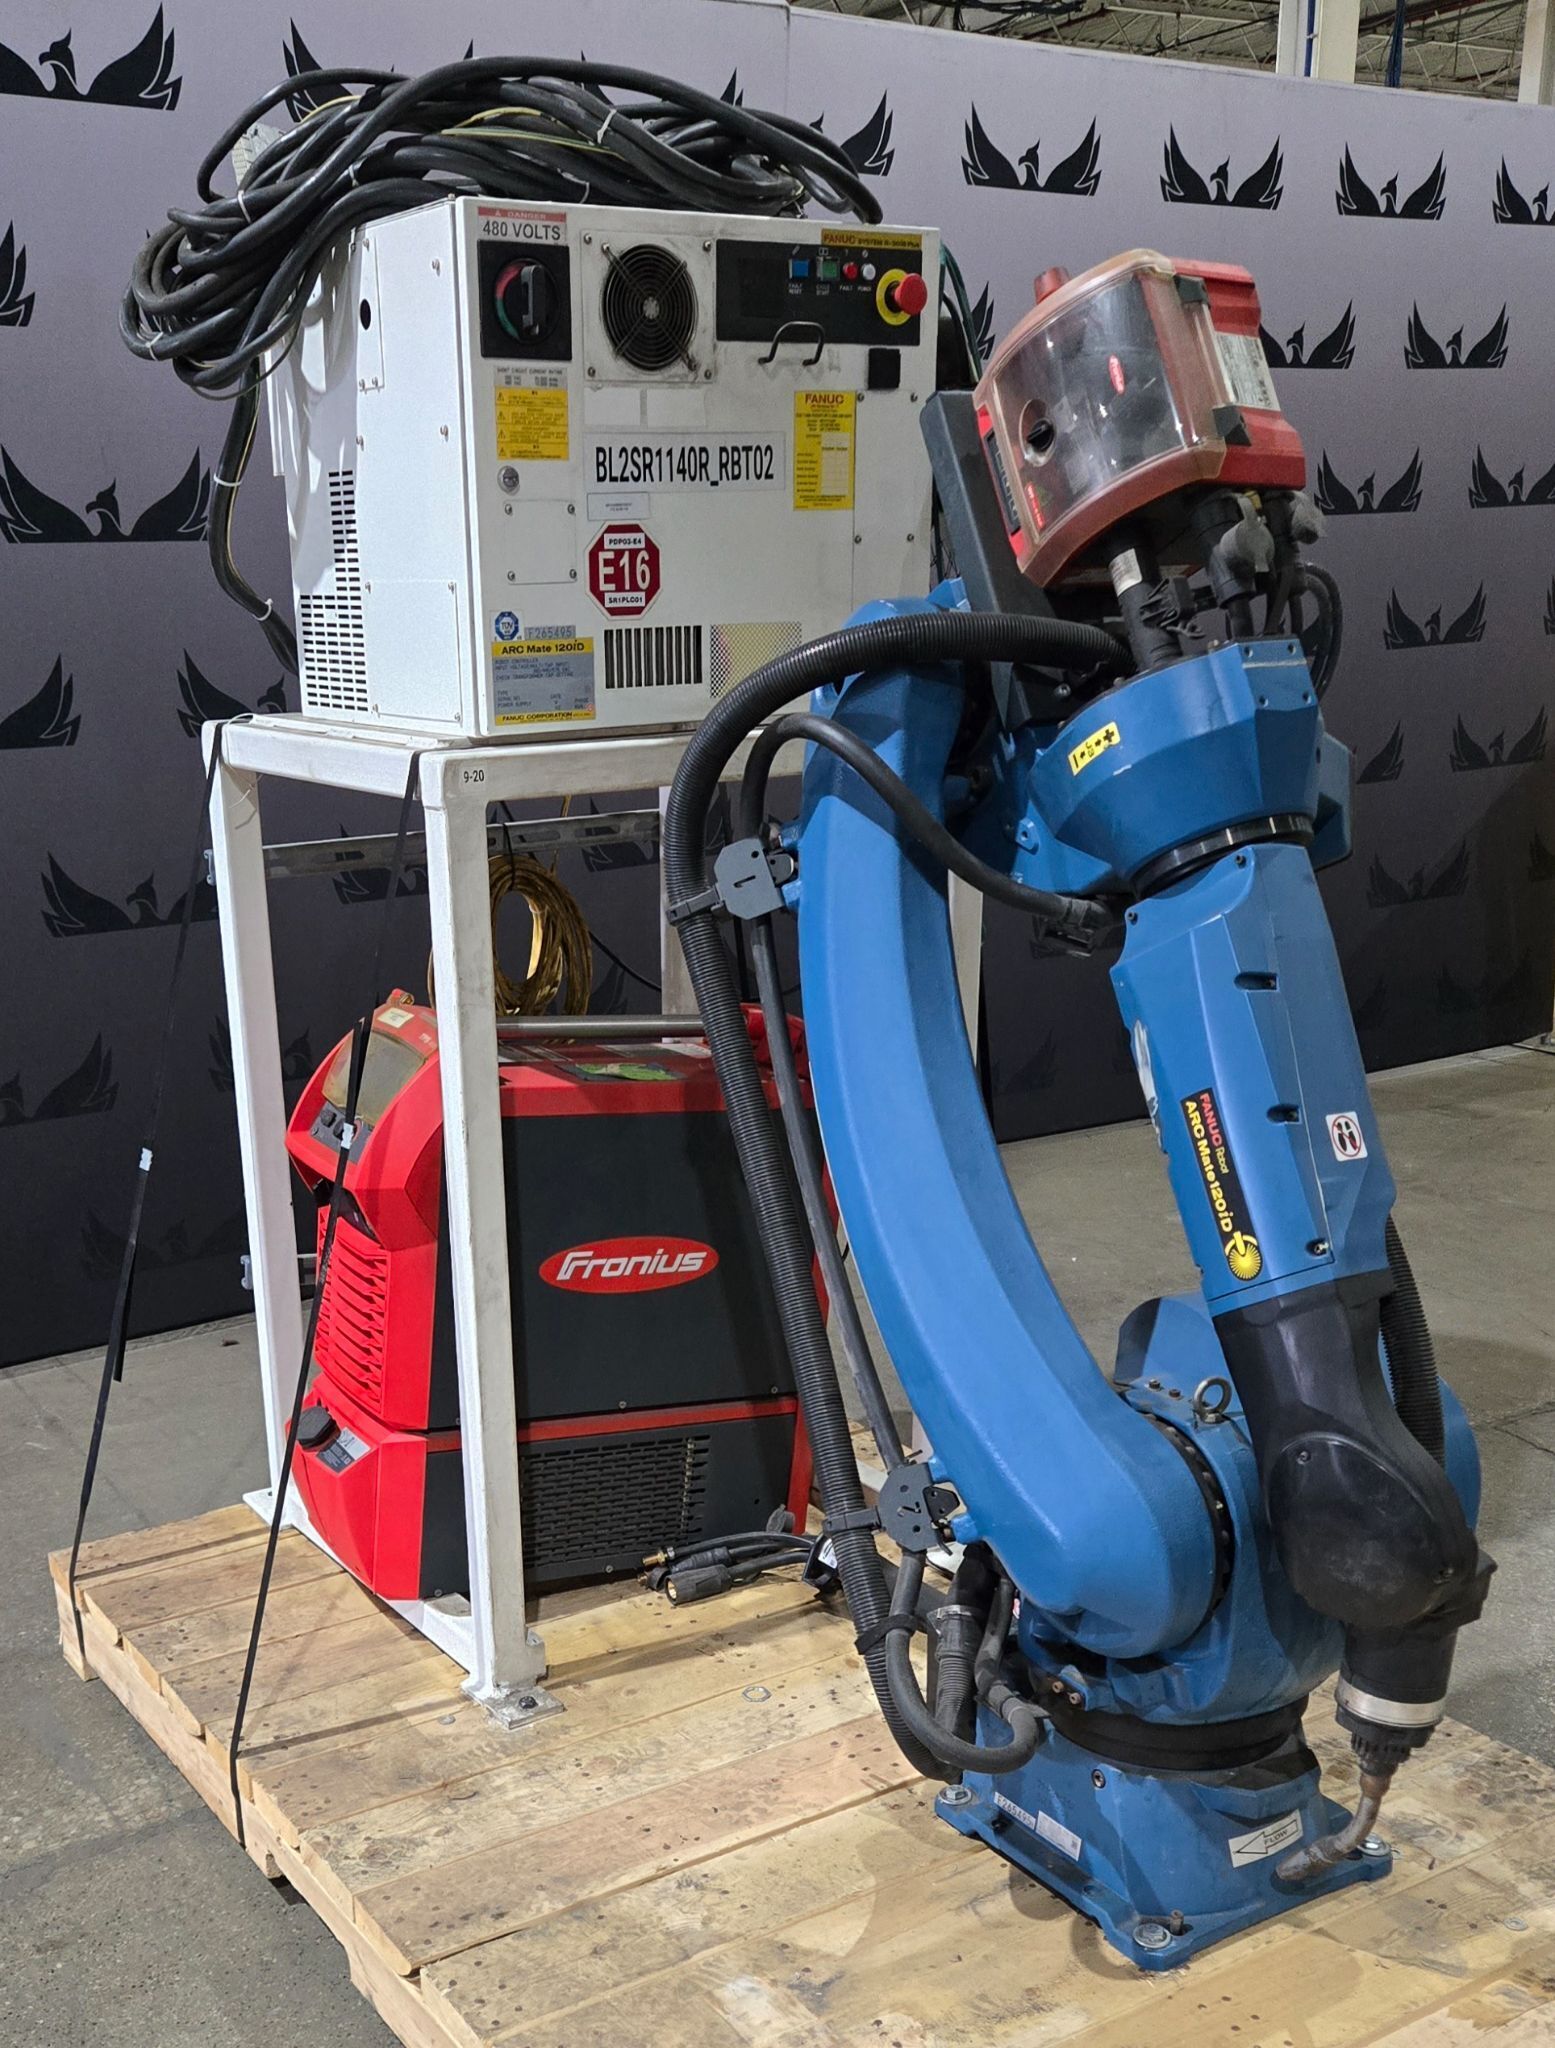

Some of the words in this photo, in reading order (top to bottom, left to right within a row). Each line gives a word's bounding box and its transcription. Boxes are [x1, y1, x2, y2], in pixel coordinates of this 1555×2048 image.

[507, 211, 546, 220] DANGER
[483, 220, 508, 237] 480
[512, 222, 561, 240] VOLTS
[823, 232, 855, 244] FANUC
[805, 393, 844, 404] FANUC
[595, 444, 775, 487] BL2SR1140R_RBT02
[598, 550, 651, 591] E16
[502, 645, 524, 655] ARC
[526, 643, 551, 653] Mate
[555, 640, 585, 652] 120iD
[526, 711, 572, 720] CORPORATION
[463, 769, 485, 783] 9-20
[1200, 1093, 1222, 1147] FANUC
[1215, 1147, 1230, 1174] Robot
[1185, 1100, 1205, 1139] ARC
[1198, 1139, 1216, 1182] Mate
[1210, 1182, 1233, 1233] 120iD
[556, 1248, 707, 1280] Fronius
[1264, 1829, 1288, 1845] FLOW
